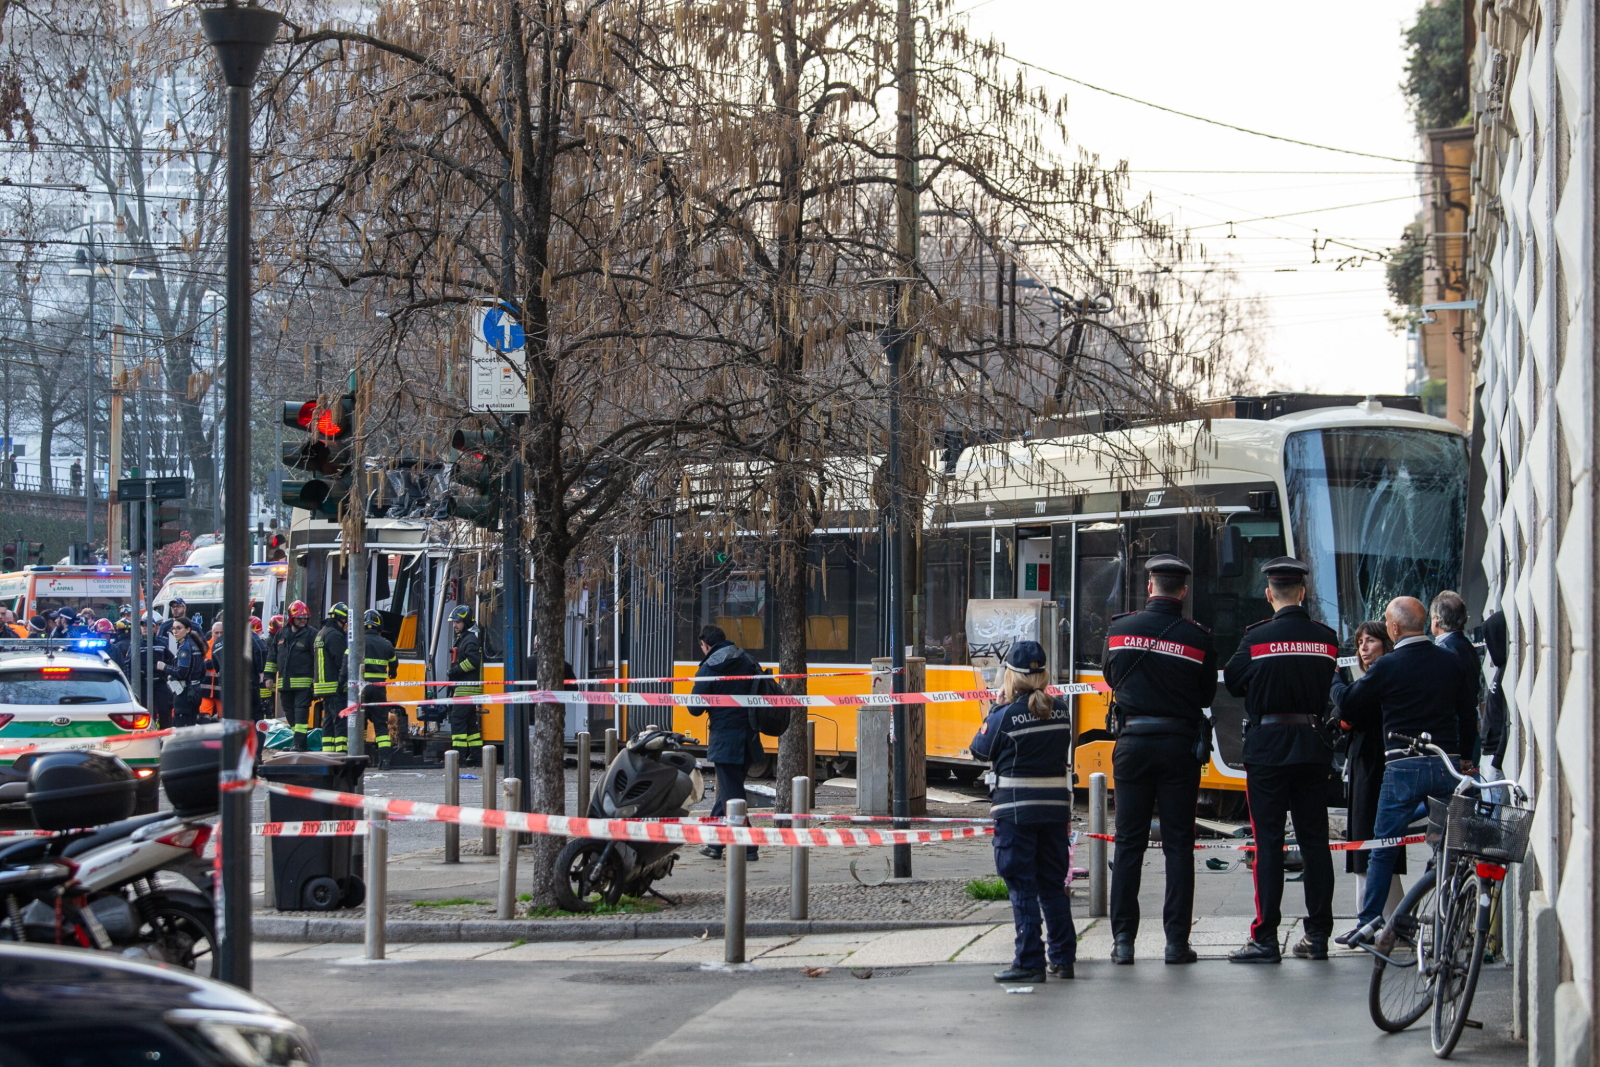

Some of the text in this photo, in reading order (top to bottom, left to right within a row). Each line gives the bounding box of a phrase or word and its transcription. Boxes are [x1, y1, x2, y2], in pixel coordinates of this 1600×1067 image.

[1123, 636, 1185, 655] CARABINIERI
[1269, 642, 1328, 654] CARABINIERI
[255, 823, 282, 834] POLIZIA
[302, 821, 355, 833] POLIZIA LOCALE
